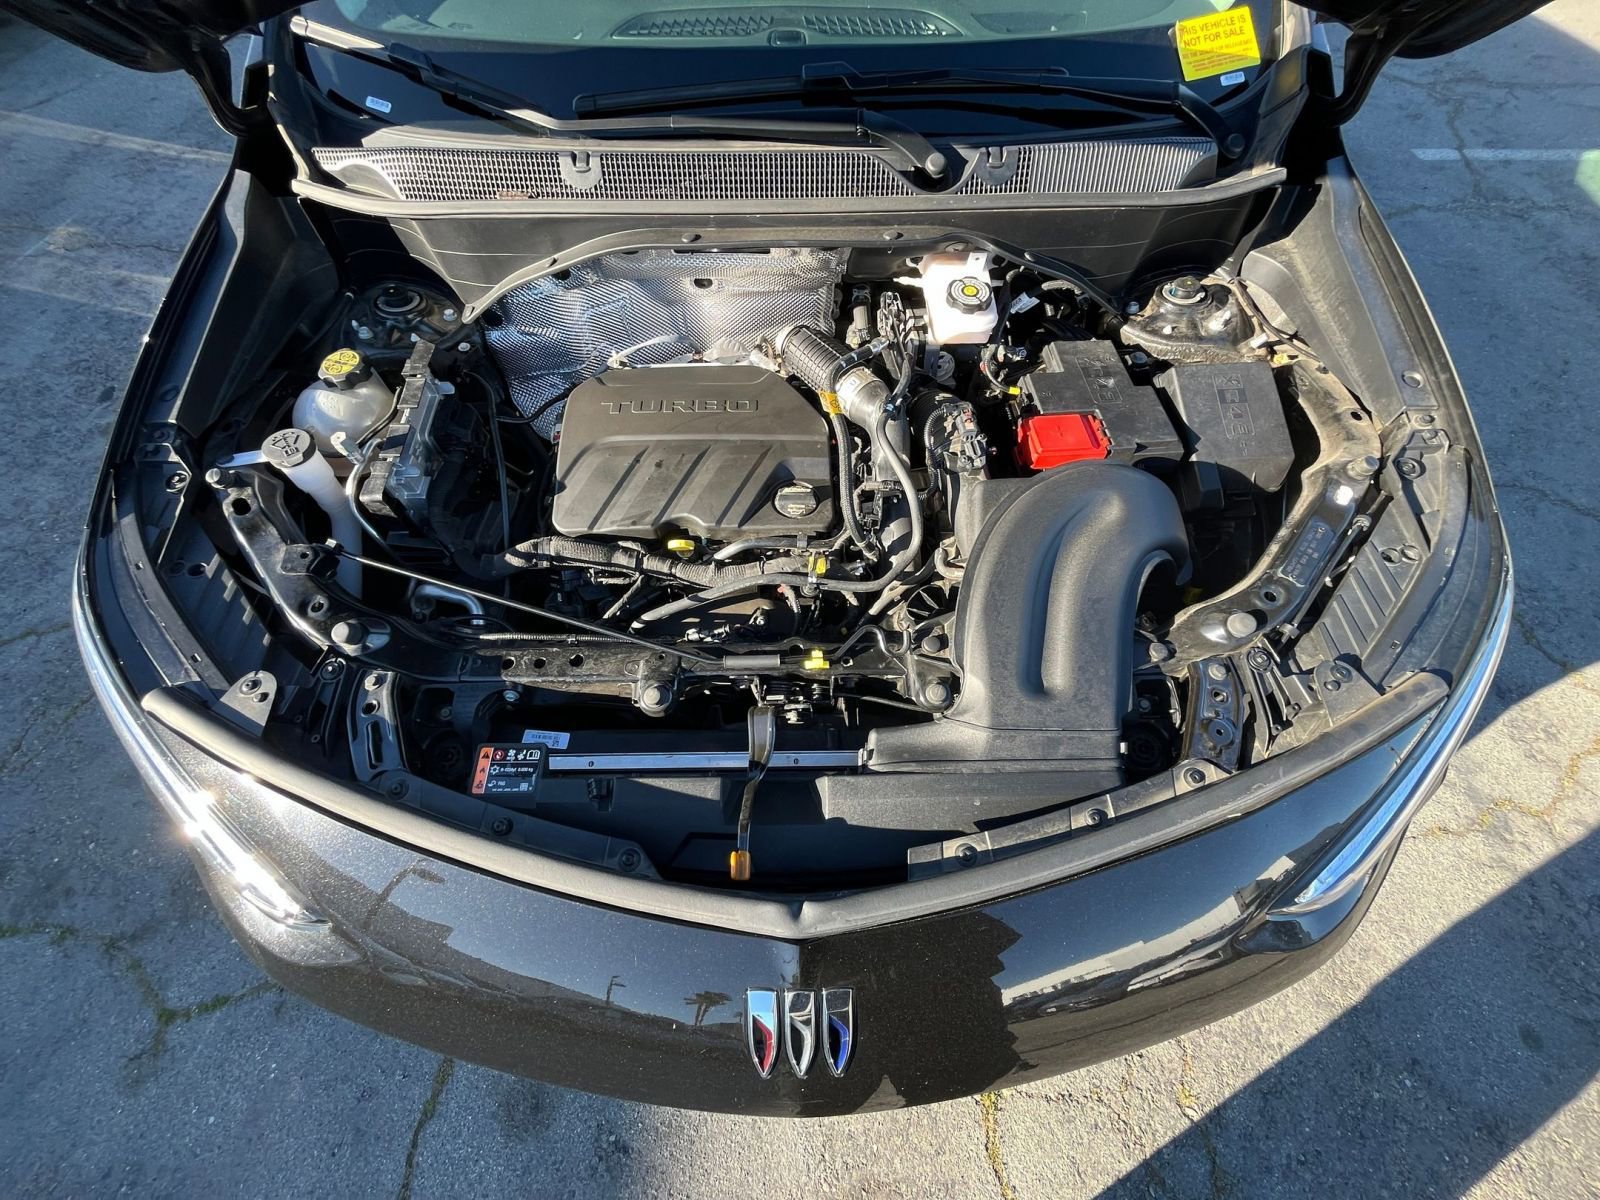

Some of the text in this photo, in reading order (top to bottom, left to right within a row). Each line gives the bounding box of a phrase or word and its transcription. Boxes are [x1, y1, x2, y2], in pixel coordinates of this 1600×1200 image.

[1200, 17, 1236, 32] VEHICLE
[1238, 14, 1246, 24] IS
[1184, 26, 1245, 48] NOT FOR SALE
[600, 400, 759, 415] TURBO
